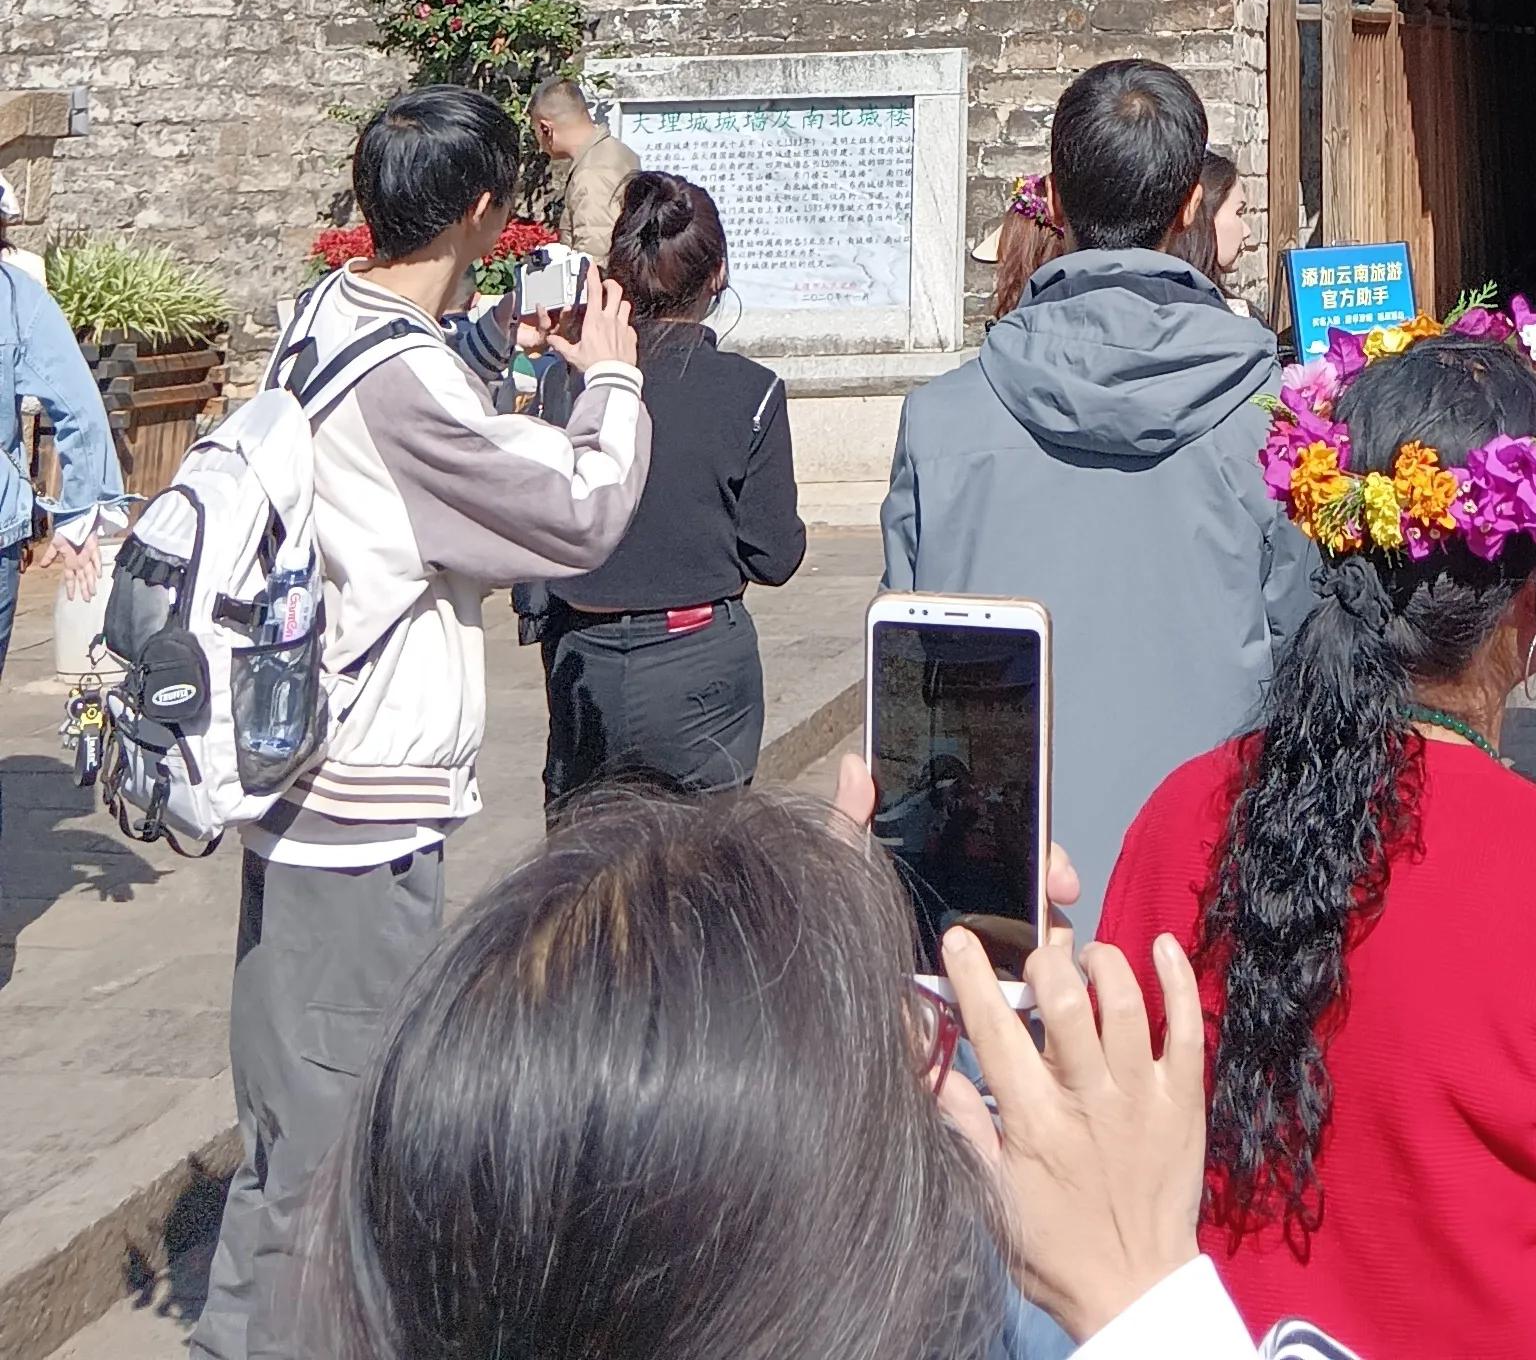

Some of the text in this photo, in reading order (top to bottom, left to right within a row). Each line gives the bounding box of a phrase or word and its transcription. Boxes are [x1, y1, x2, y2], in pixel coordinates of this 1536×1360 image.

[1300, 261, 1403, 288] 添加云南旅游
[1321, 285, 1390, 310] 官方助手
